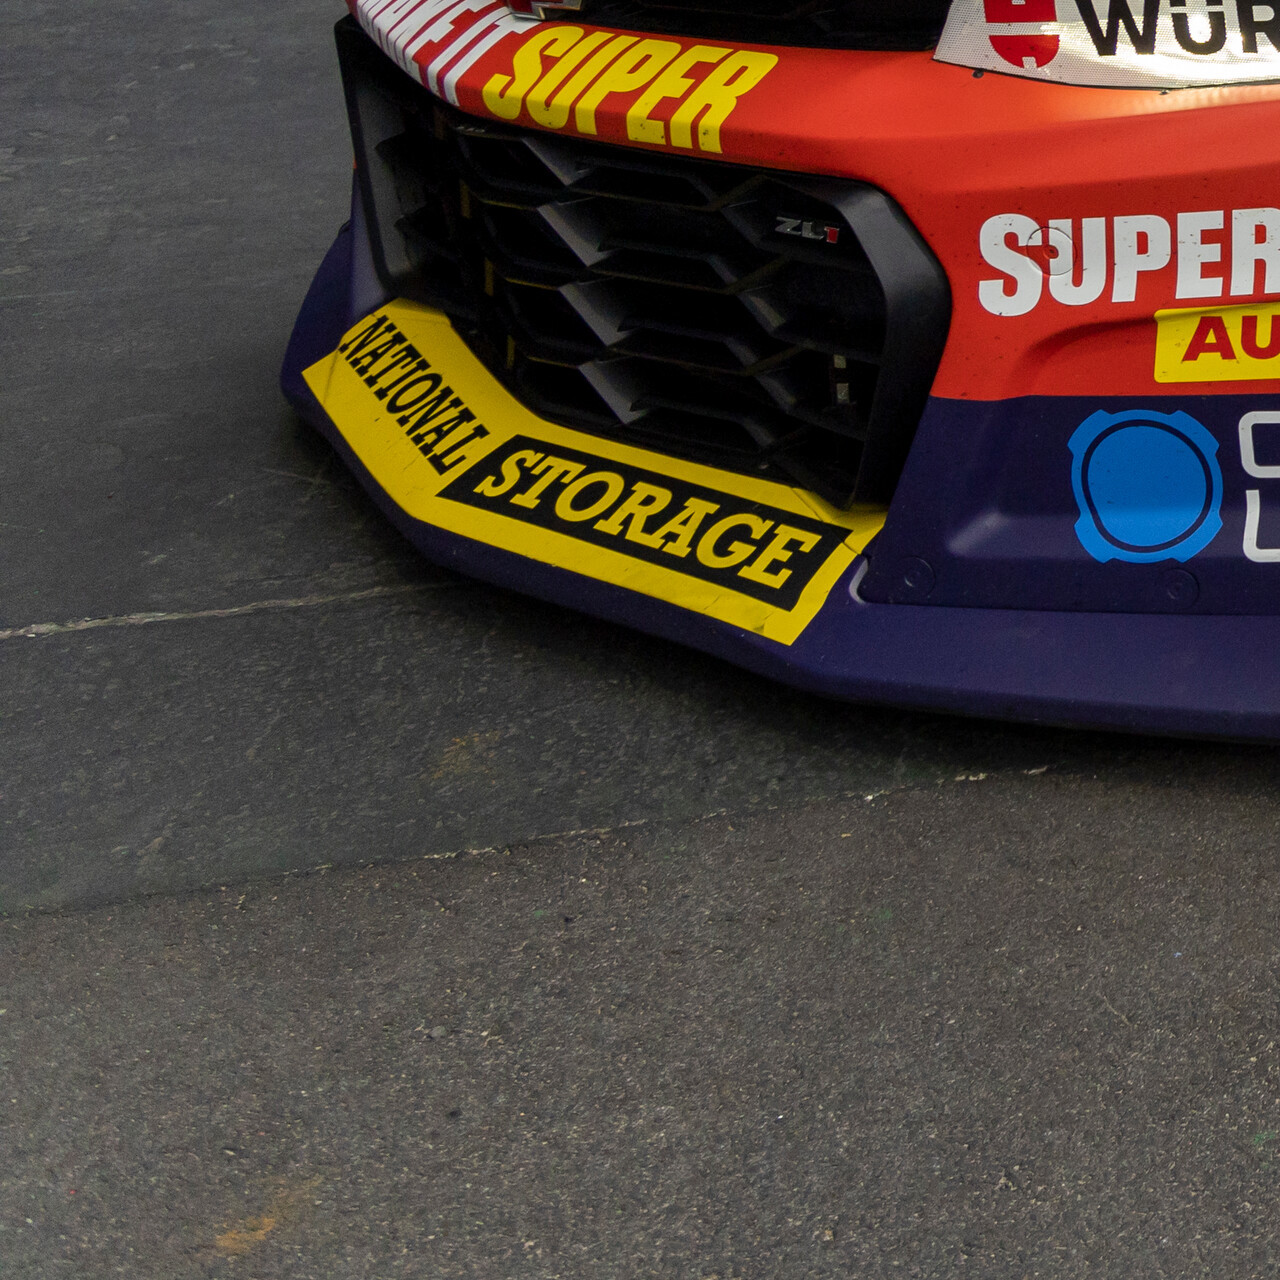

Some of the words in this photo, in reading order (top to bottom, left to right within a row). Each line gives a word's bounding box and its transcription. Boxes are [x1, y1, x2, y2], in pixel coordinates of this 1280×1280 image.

[427, 6, 541, 108] IT
[482, 25, 779, 154] SUPER
[774, 216, 840, 244] ZL1
[339, 314, 491, 476] NATIONAL
[473, 449, 822, 589] STORAGE
